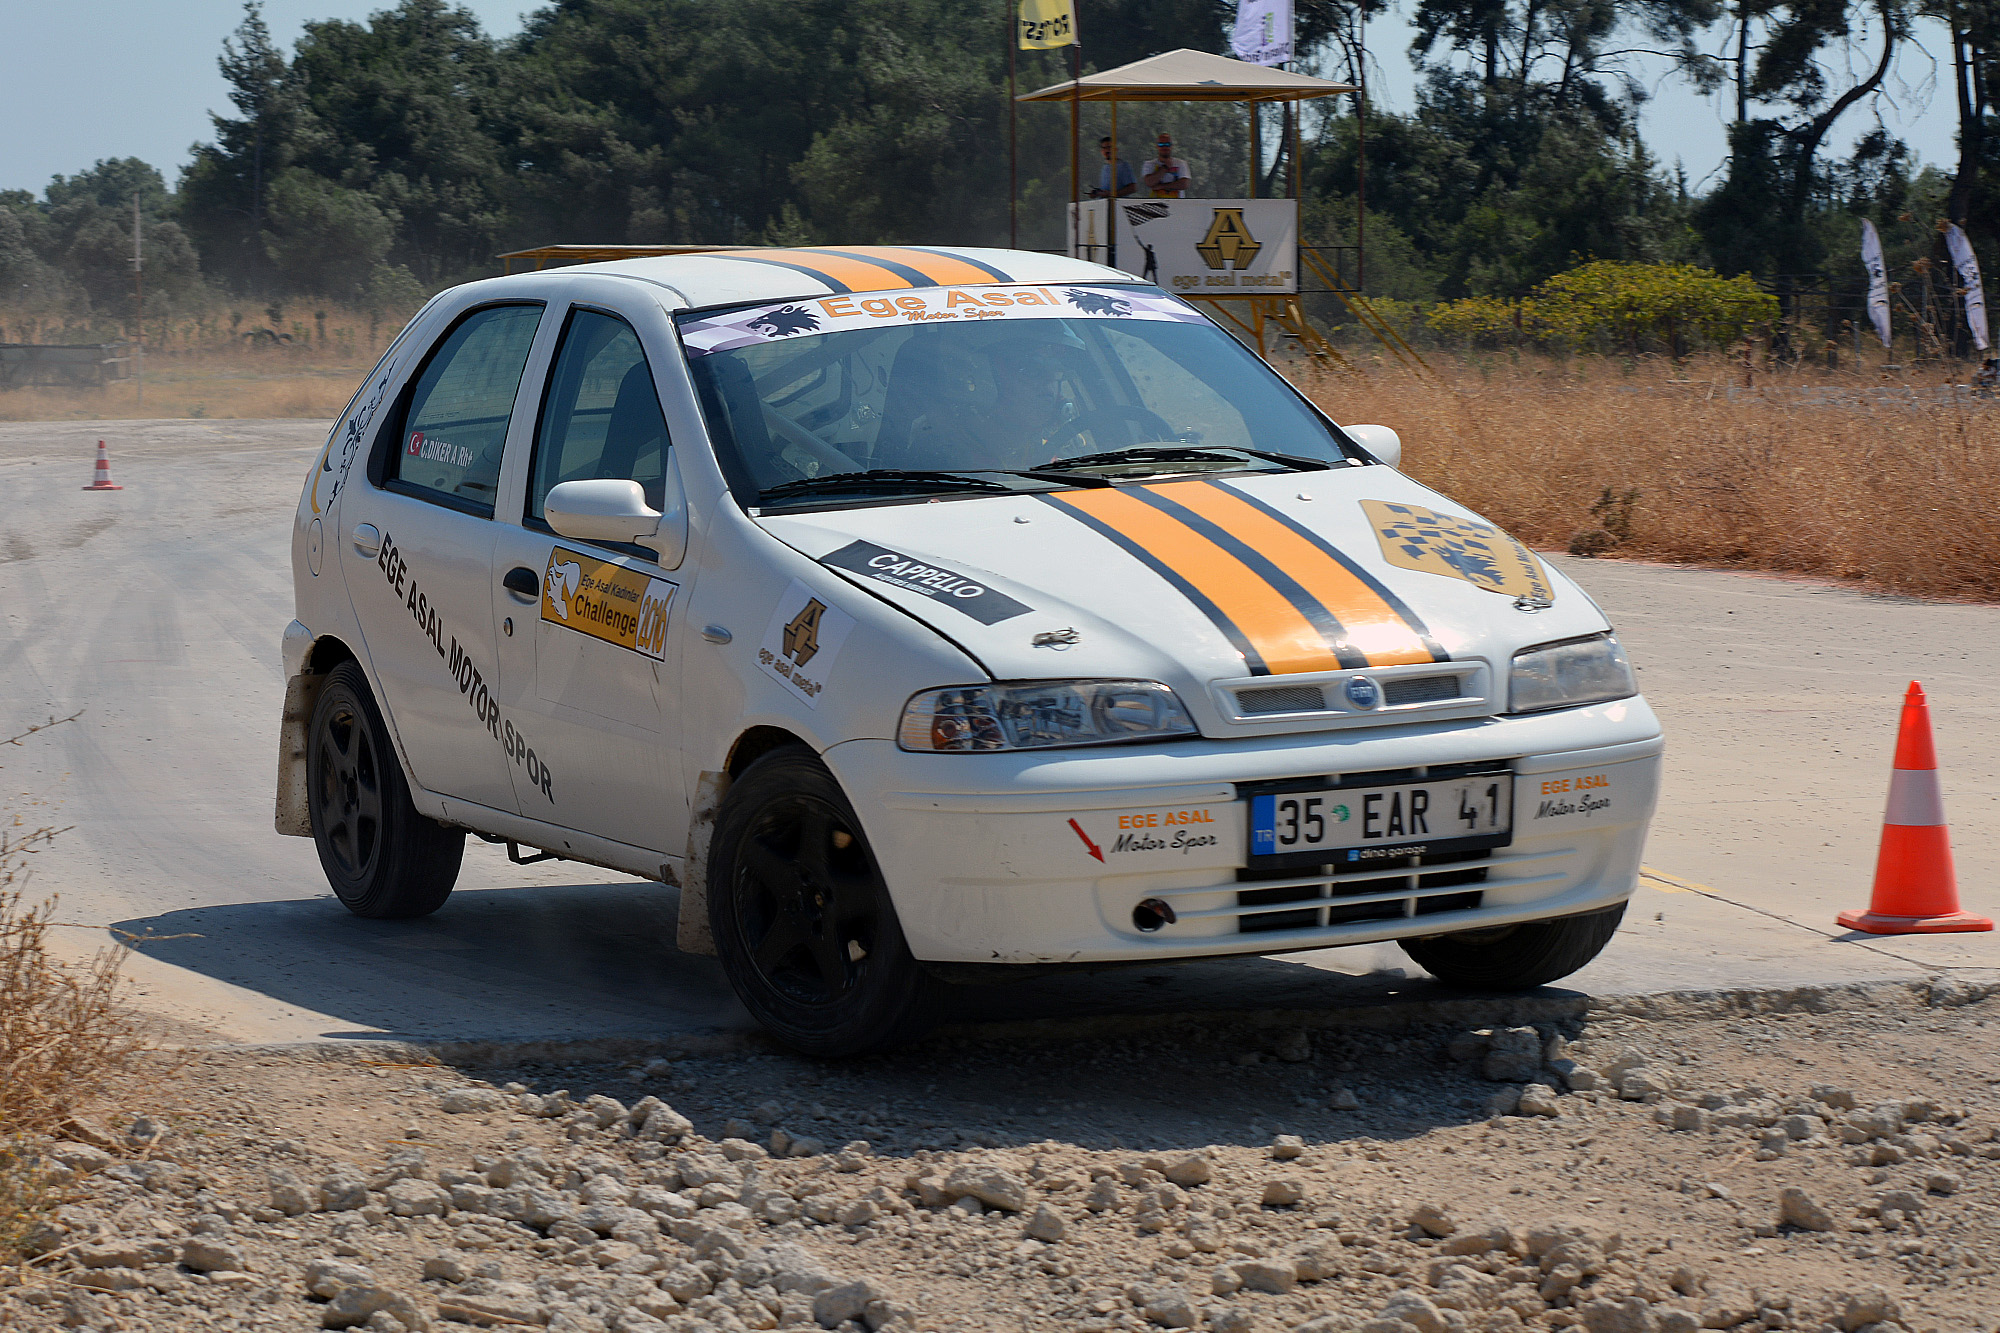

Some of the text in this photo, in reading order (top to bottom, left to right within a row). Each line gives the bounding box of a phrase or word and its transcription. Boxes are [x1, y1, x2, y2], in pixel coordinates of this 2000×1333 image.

[1172, 275, 1200, 290] ege
[1205, 271, 1236, 286] asal
[817, 288, 1062, 318] Ege Asal
[902, 308, 1005, 322] Motor Spor
[450, 445, 458, 465] A
[581, 574, 595, 590] Ege
[594, 579, 612, 594] Asal
[867, 554, 985, 598] CAPPELLO
[575, 594, 637, 637] Challenge
[637, 587, 675, 654] 2016
[377, 531, 555, 804] EGE ASAL MOTOR SPOR
[759, 648, 775, 665] ege
[774, 659, 795, 679] asal
[1541, 774, 1611, 795] EGE ASAL
[1279, 783, 1499, 845] 35 EAR 41
[1533, 793, 1611, 819] Motor Spor
[1118, 809, 1215, 829] EGE ASAL
[1110, 830, 1218, 855] Motor Spor
[1256, 829, 1274, 842] TR
[1388, 845, 1428, 858] garage
